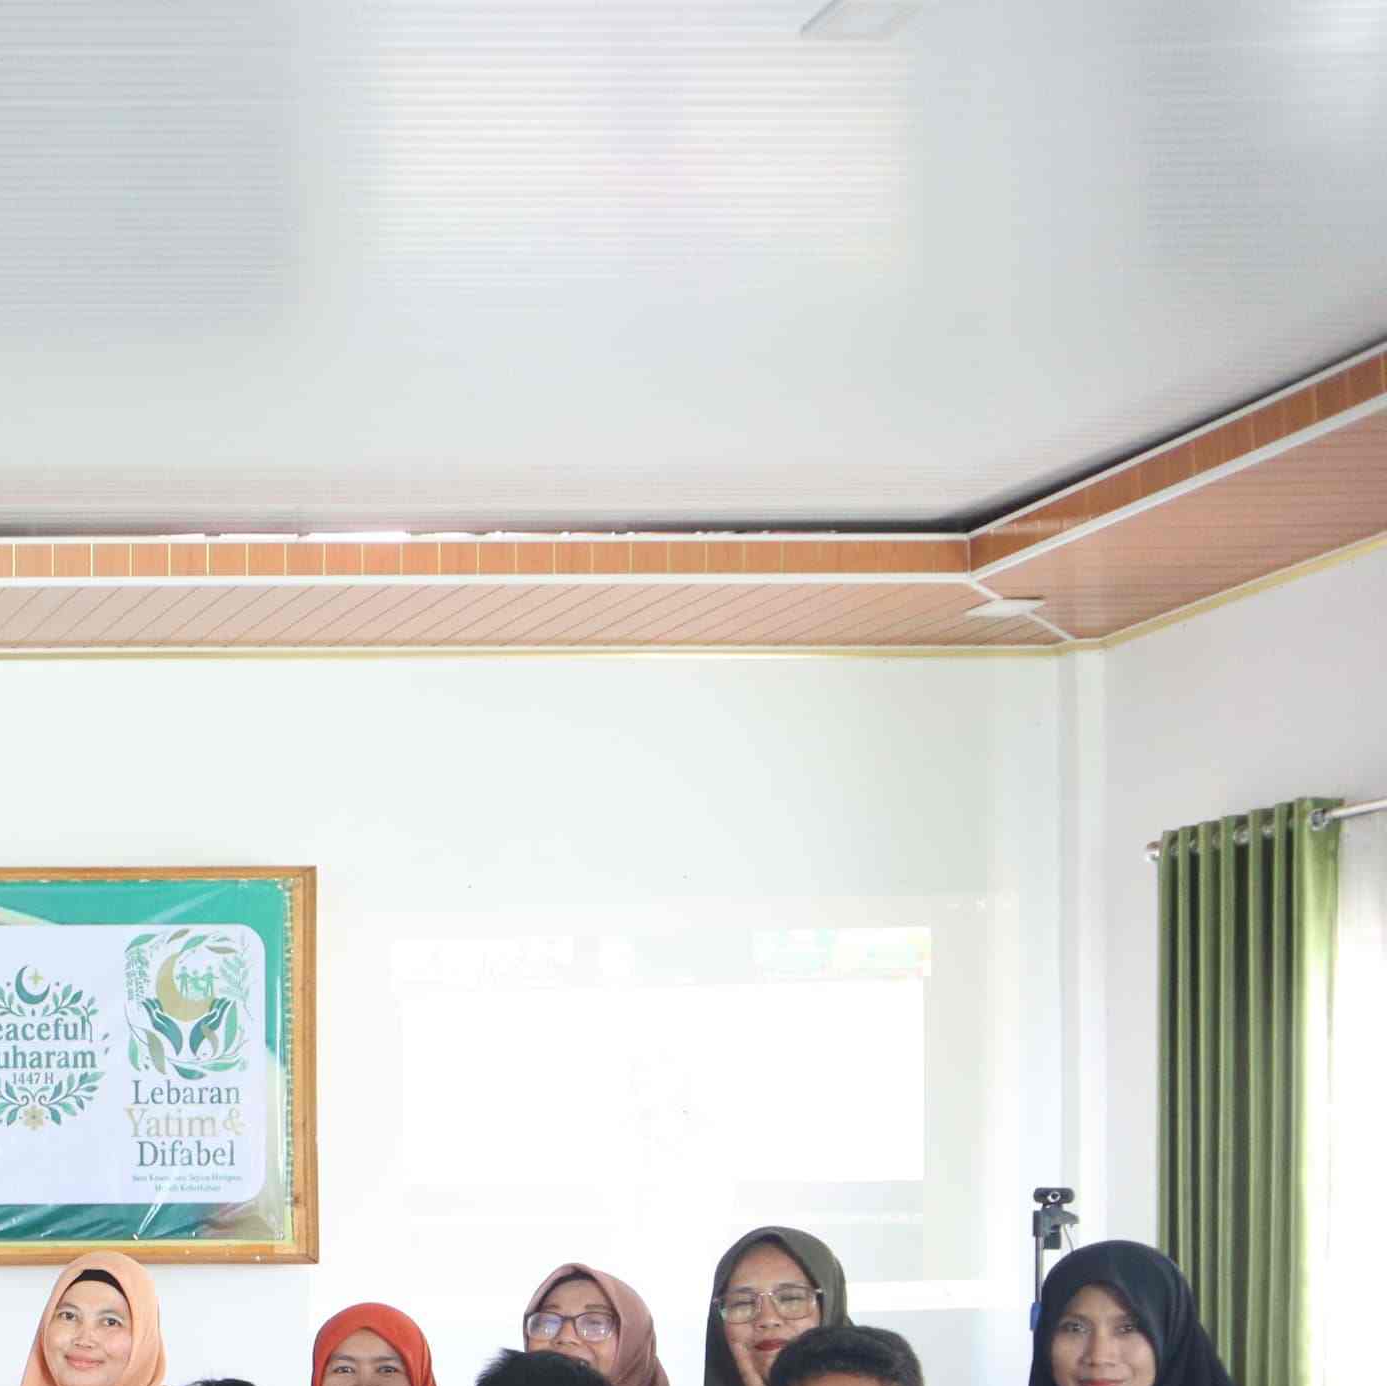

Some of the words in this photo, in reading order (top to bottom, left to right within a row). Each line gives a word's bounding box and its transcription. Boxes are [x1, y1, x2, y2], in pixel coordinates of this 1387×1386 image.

[12, 1072, 39, 1085] 1447
[44, 1072, 55, 1084] H
[133, 1079, 243, 1105] Lebaran
[125, 1107, 218, 1137] Yatim
[223, 1107, 246, 1136] &
[136, 1139, 236, 1167] Difabel
